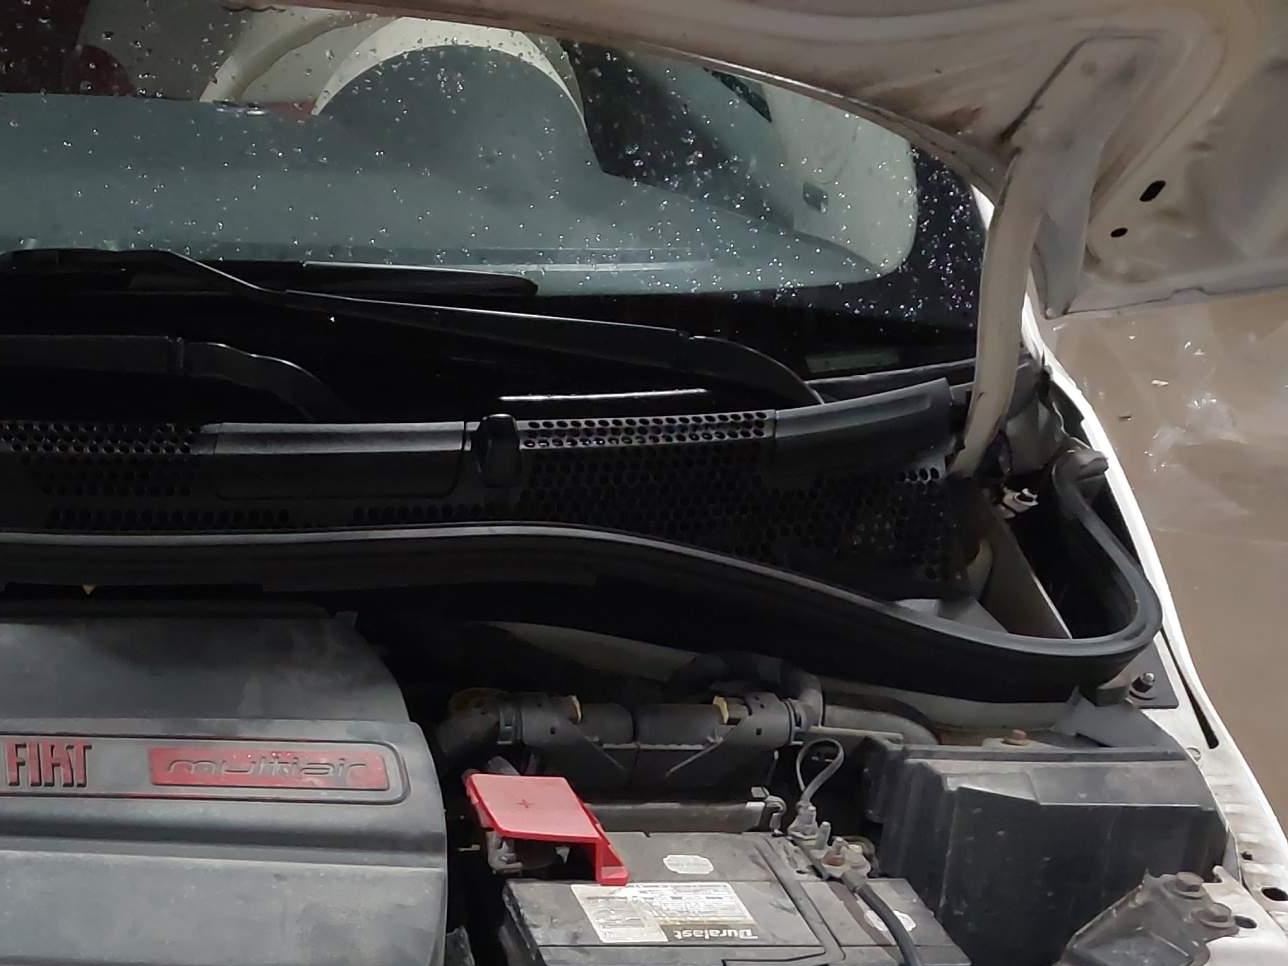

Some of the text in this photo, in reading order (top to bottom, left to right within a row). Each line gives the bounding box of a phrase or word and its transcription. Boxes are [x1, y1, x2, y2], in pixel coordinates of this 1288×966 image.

[4, 740, 368, 788] FIAT multiair
[673, 928, 759, 940] Duralast
